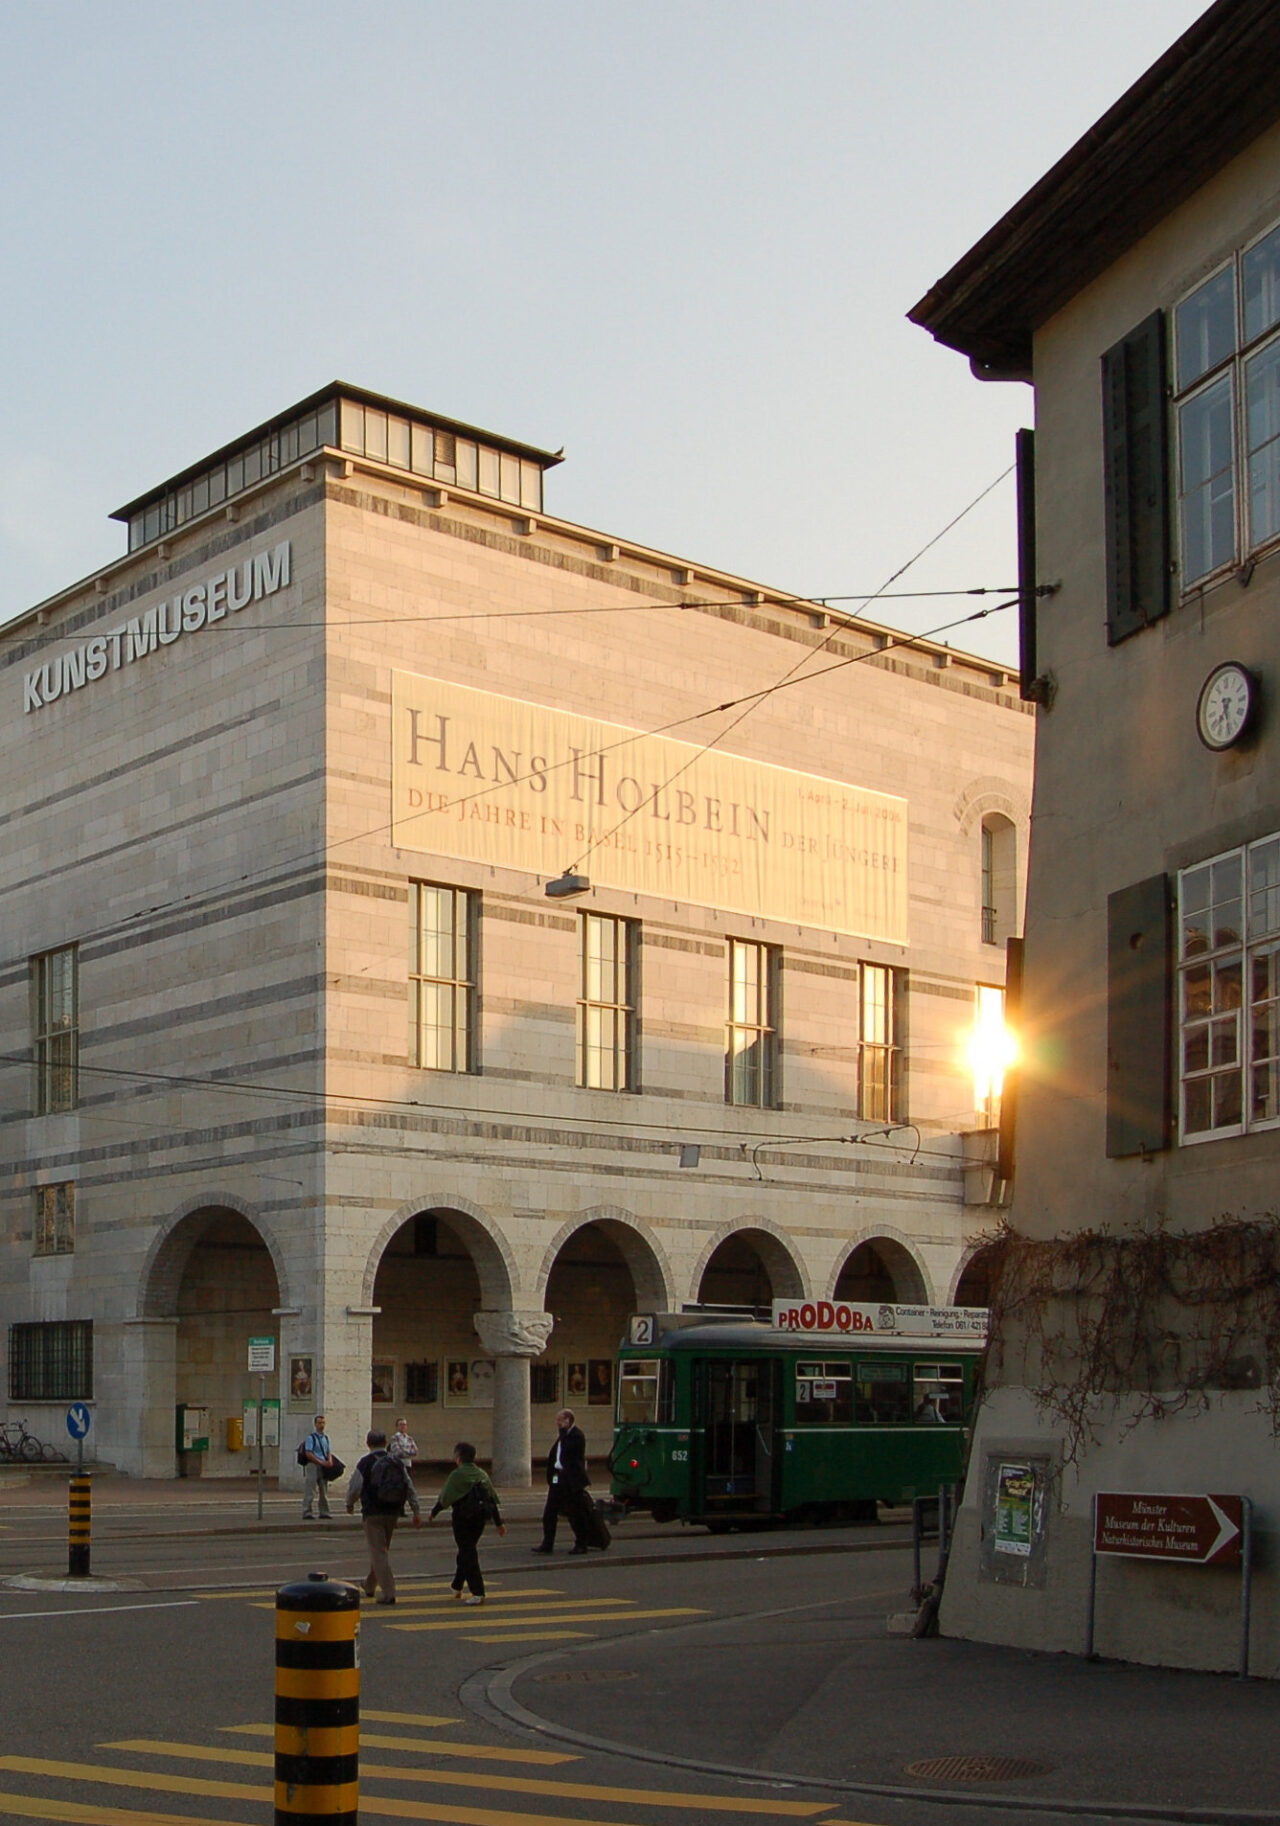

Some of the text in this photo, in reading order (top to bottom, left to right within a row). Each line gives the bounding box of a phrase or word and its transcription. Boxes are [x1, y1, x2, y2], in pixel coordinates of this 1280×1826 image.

[23, 540, 292, 714] KUNSTMUSEUM
[407, 788, 451, 815] DIE
[458, 798, 531, 831] JAHRE
[540, 816, 564, 837] IN
[574, 823, 638, 853] BASEL
[777, 1301, 874, 1332] PRODOBA
[895, 1306, 925, 1317] Container
[636, 1319, 650, 1343] 2
[932, 1319, 954, 1330] Telefon
[799, 1383, 807, 1401] 2
[671, 1450, 689, 1462] 652
[1131, 1500, 1168, 1514] Münster
[1104, 1515, 1197, 1534] Museum der Kulturen
[1165, 1535, 1199, 1551] Museum
